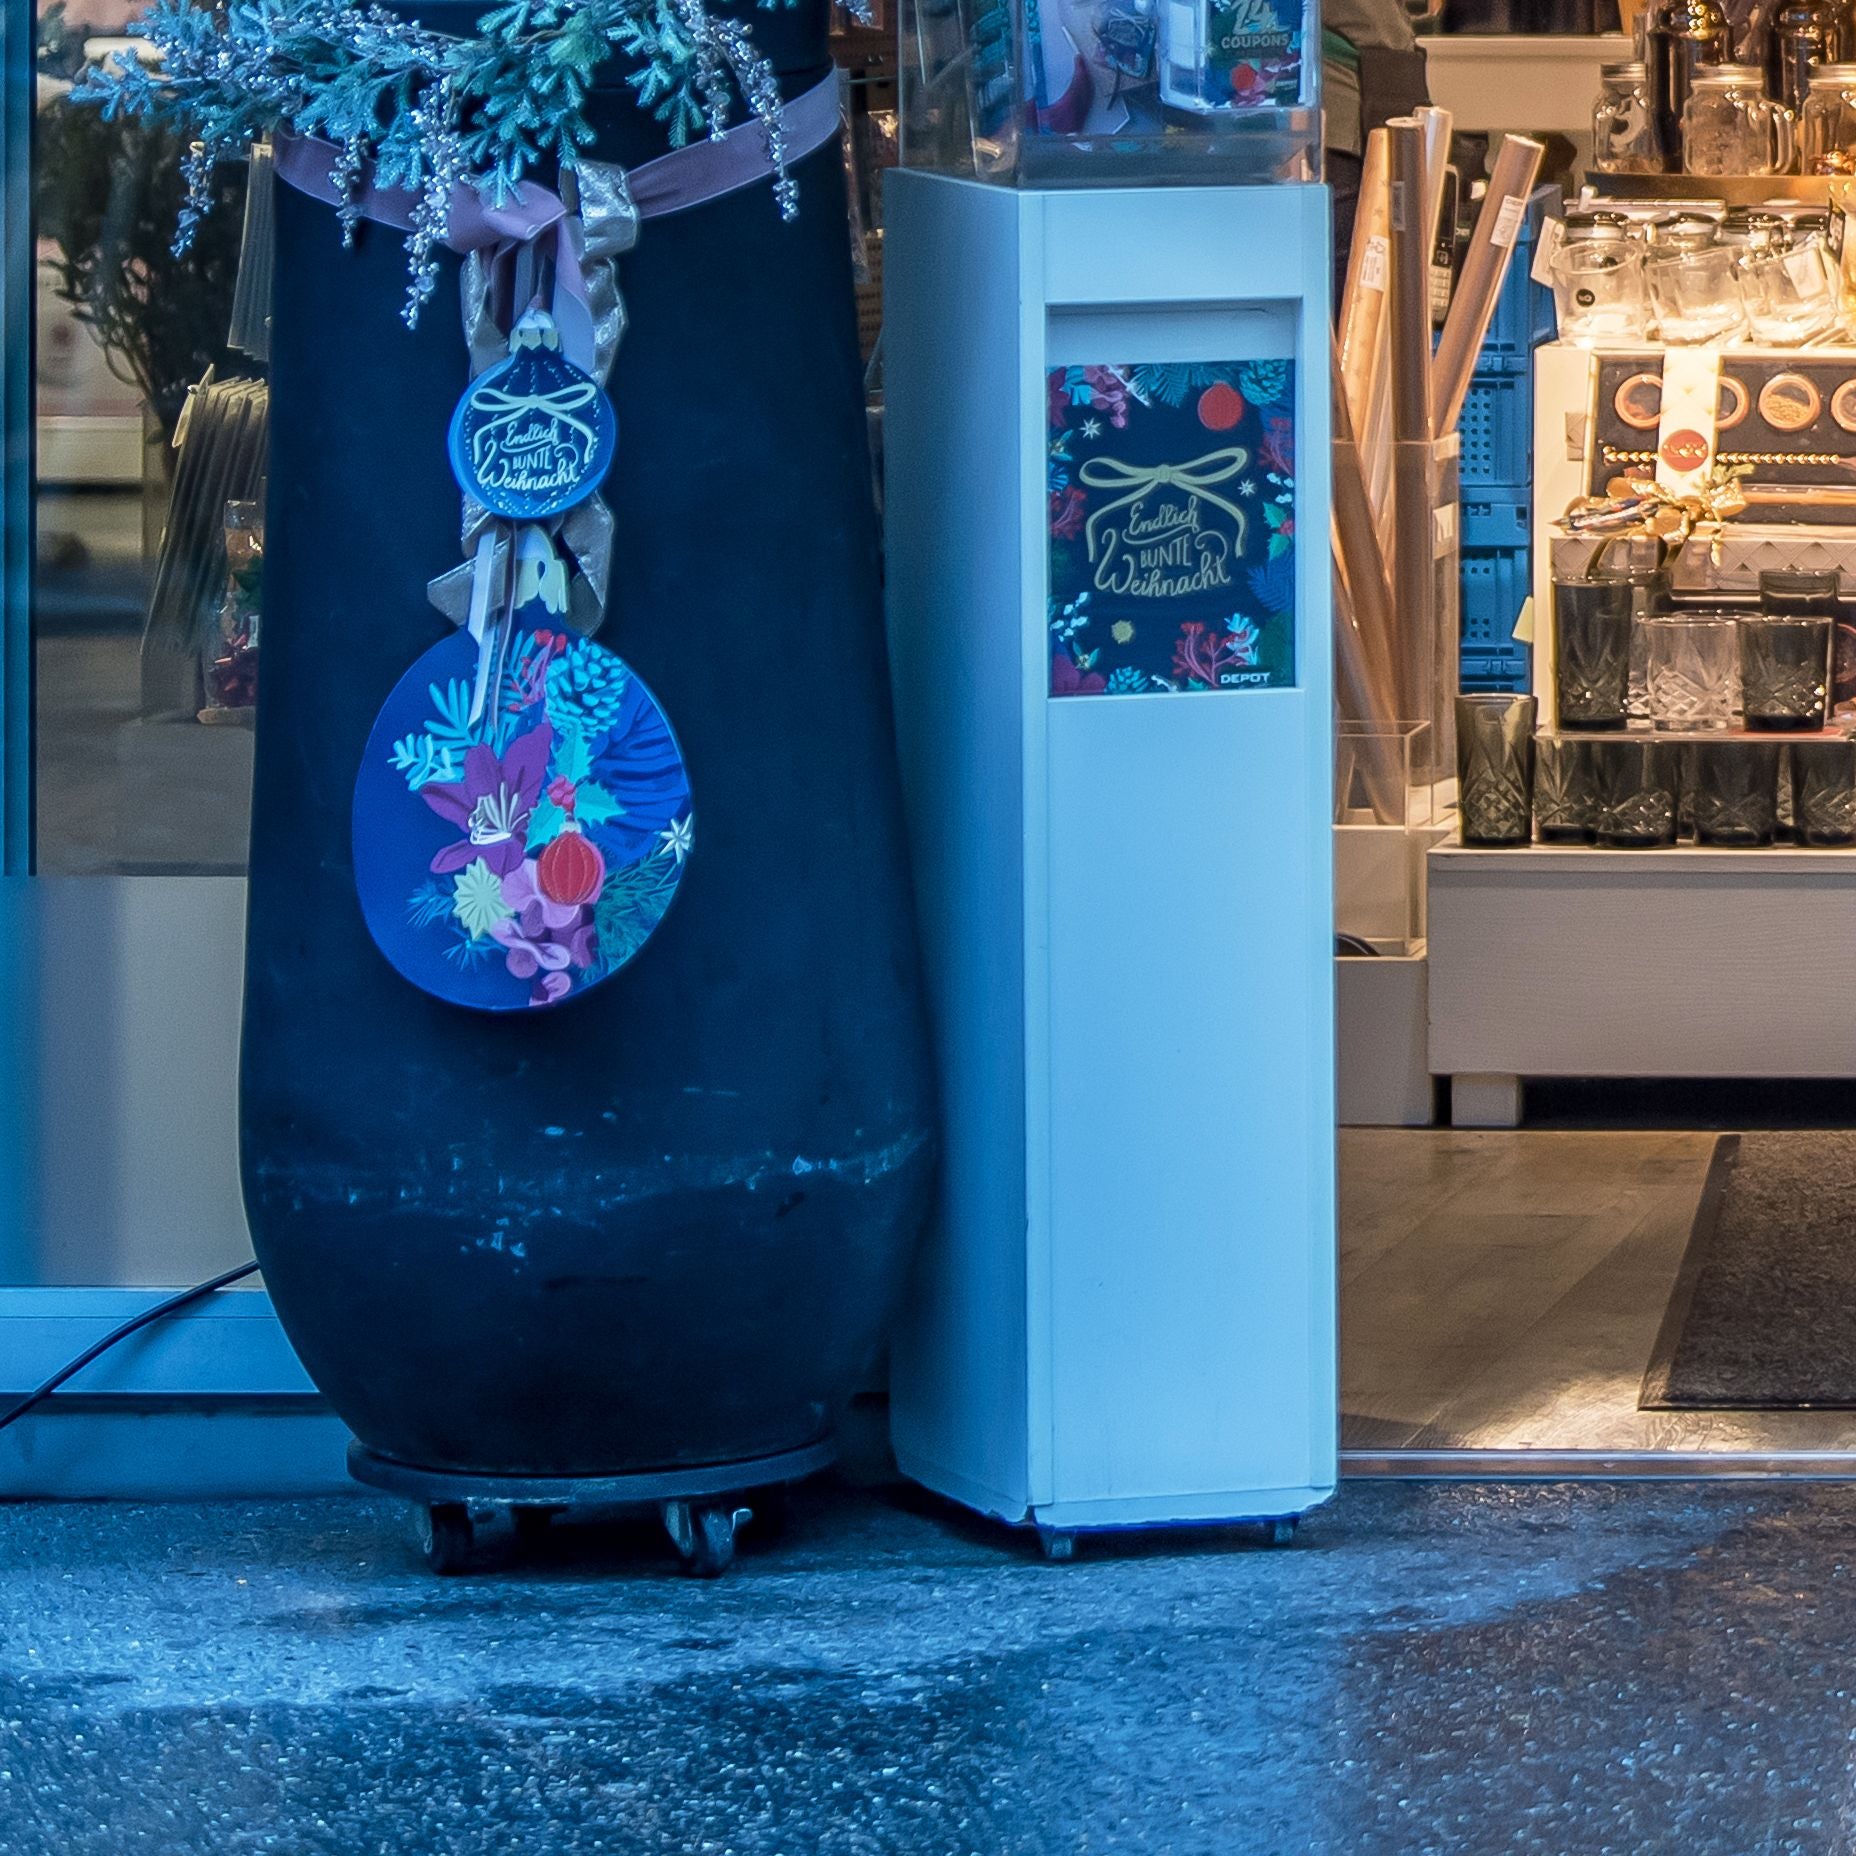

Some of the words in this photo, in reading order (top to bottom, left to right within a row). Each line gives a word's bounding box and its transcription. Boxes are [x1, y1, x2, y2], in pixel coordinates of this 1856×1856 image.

[1221, 34, 1290, 50] COUPONS
[504, 417, 560, 447] Endlich
[477, 440, 580, 491] Weihnacht
[1125, 495, 1200, 540] Endlich
[1094, 528, 1231, 598] Weihnacht
[1140, 534, 1192, 569] BUNTE
[1219, 672, 1271, 685] DEPOT
